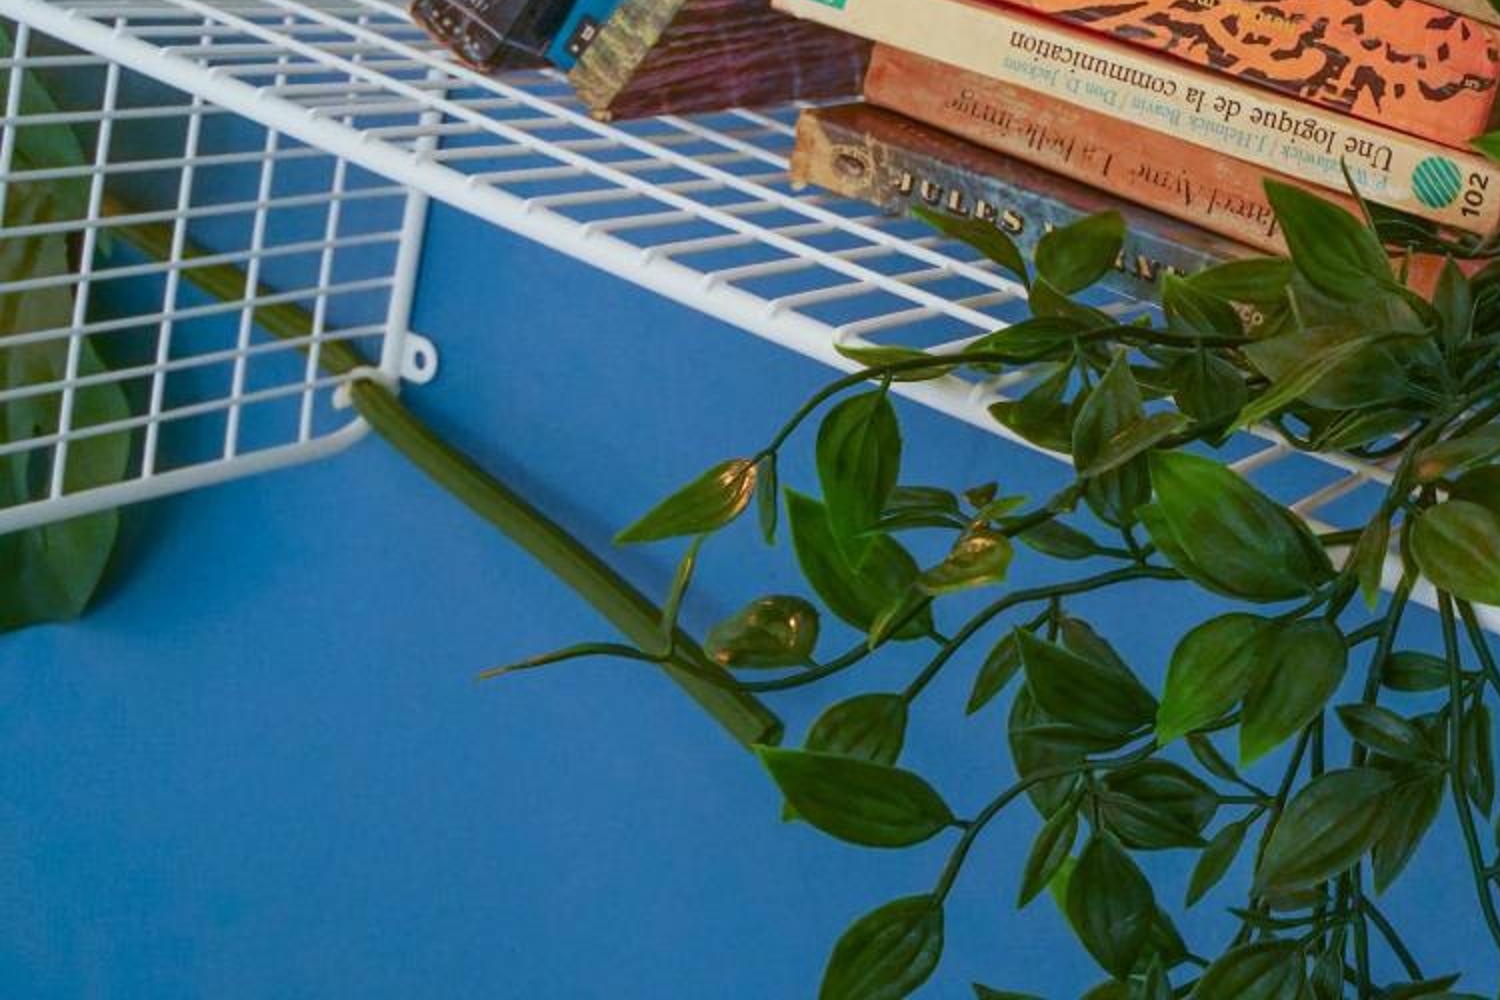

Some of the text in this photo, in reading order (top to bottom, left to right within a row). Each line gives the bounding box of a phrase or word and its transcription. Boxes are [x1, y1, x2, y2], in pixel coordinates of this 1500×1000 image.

[1007, 29, 1395, 173] Une logique de la communication
[1459, 171, 1490, 220] 102
